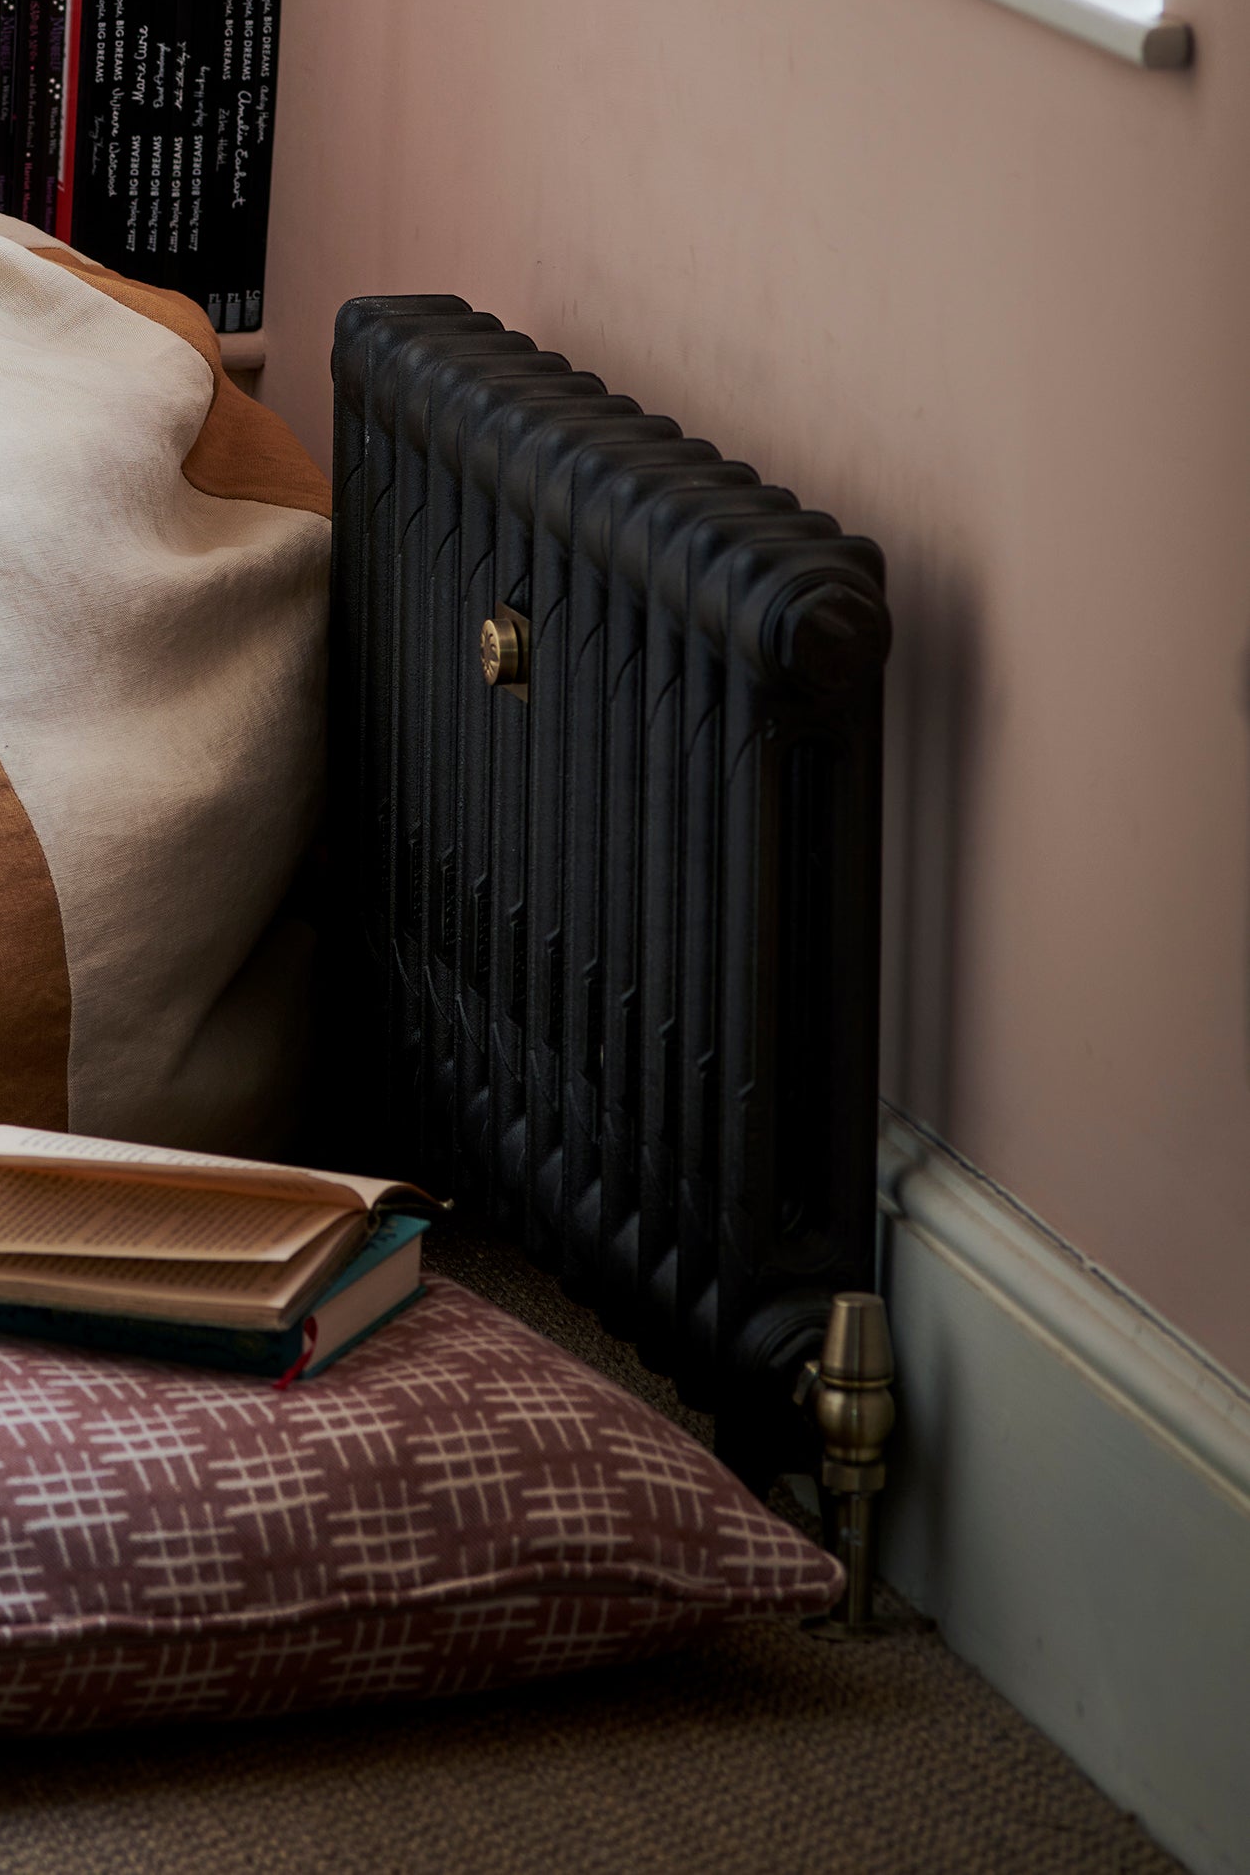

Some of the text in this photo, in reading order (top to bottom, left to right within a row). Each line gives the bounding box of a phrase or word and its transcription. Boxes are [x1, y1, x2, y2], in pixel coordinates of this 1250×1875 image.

[95, 41, 105, 83] DREAMS
[114, 39, 124, 81] DREAMS
[223, 39, 232, 80] DREAMS
[242, 39, 253, 80] DREAMS
[261, 36, 272, 77] DREAMS
[130, 135, 141, 175] DREAMS
[151, 135, 162, 176] DREAMS
[172, 137, 183, 177] DREAMS
[192, 135, 203, 175] DREAMS
